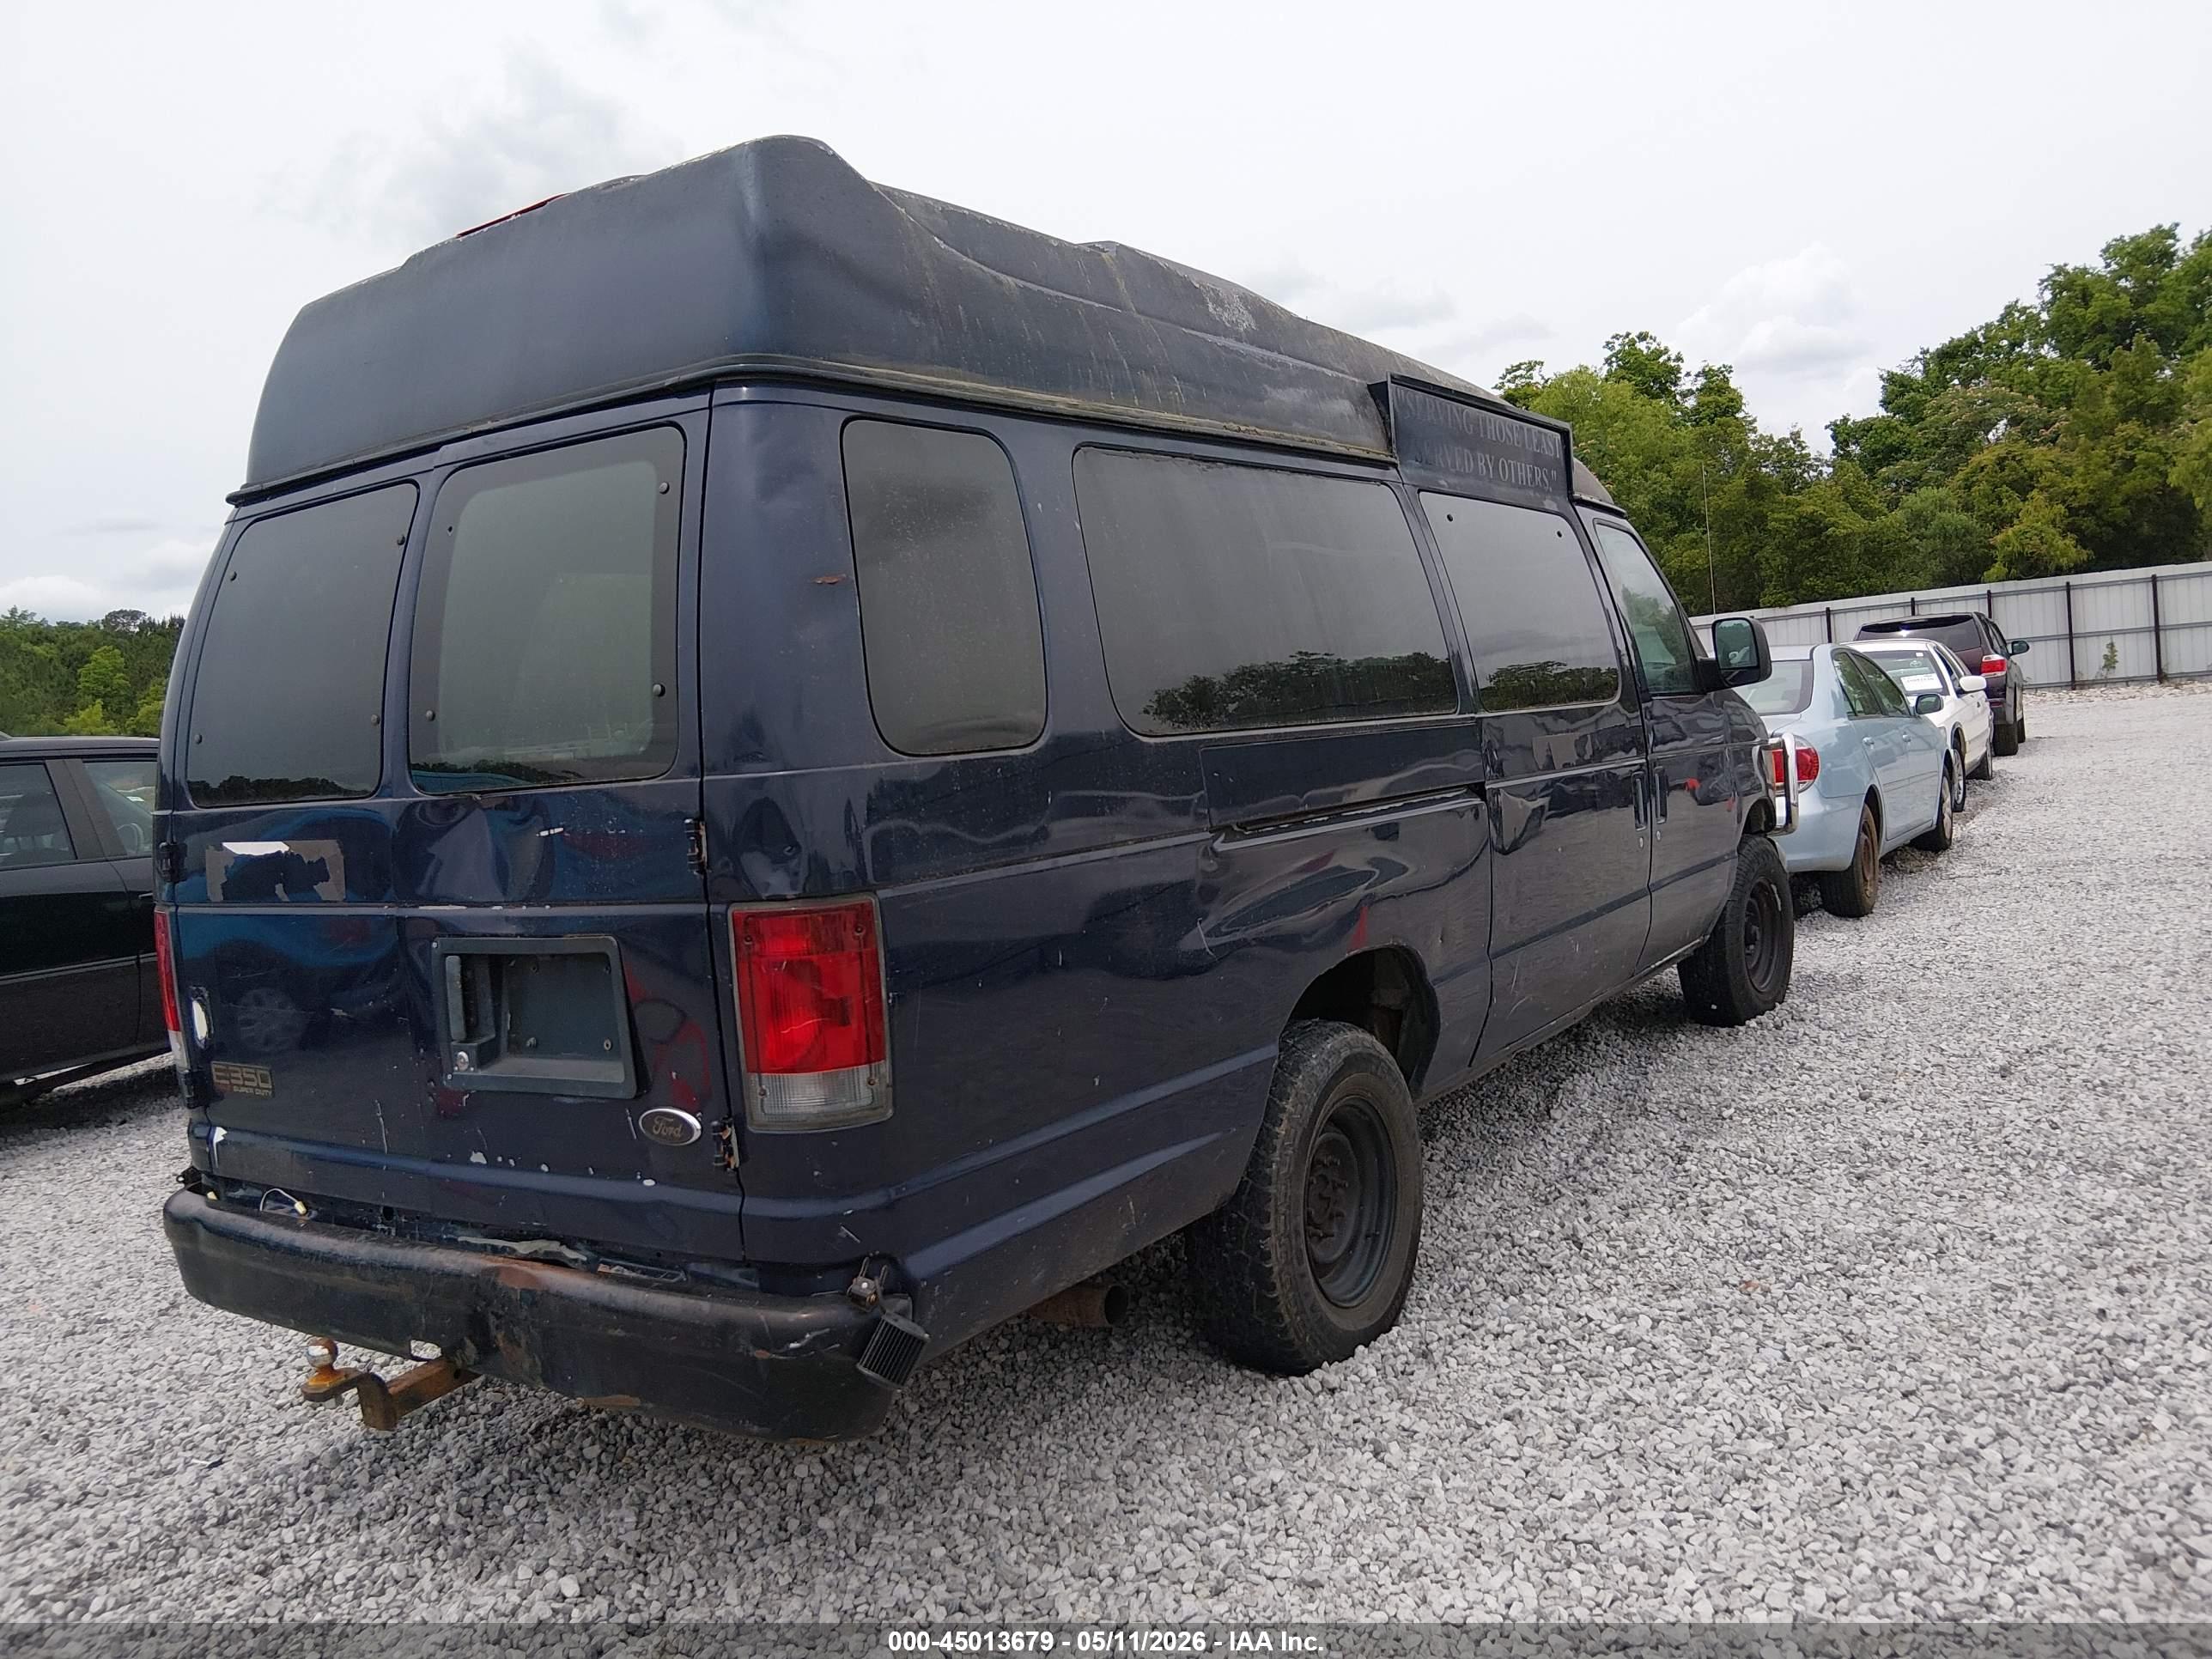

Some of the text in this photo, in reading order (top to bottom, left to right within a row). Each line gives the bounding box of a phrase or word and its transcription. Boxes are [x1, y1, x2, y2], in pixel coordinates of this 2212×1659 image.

[1478, 413, 1522, 447] THOSE
[1523, 426, 1561, 458] LEAST
[1477, 453, 1494, 478] BY
[1498, 458, 1557, 492] OTHERS."
[212, 1065, 272, 1089] E350
[652, 1116, 684, 1138] Ford
